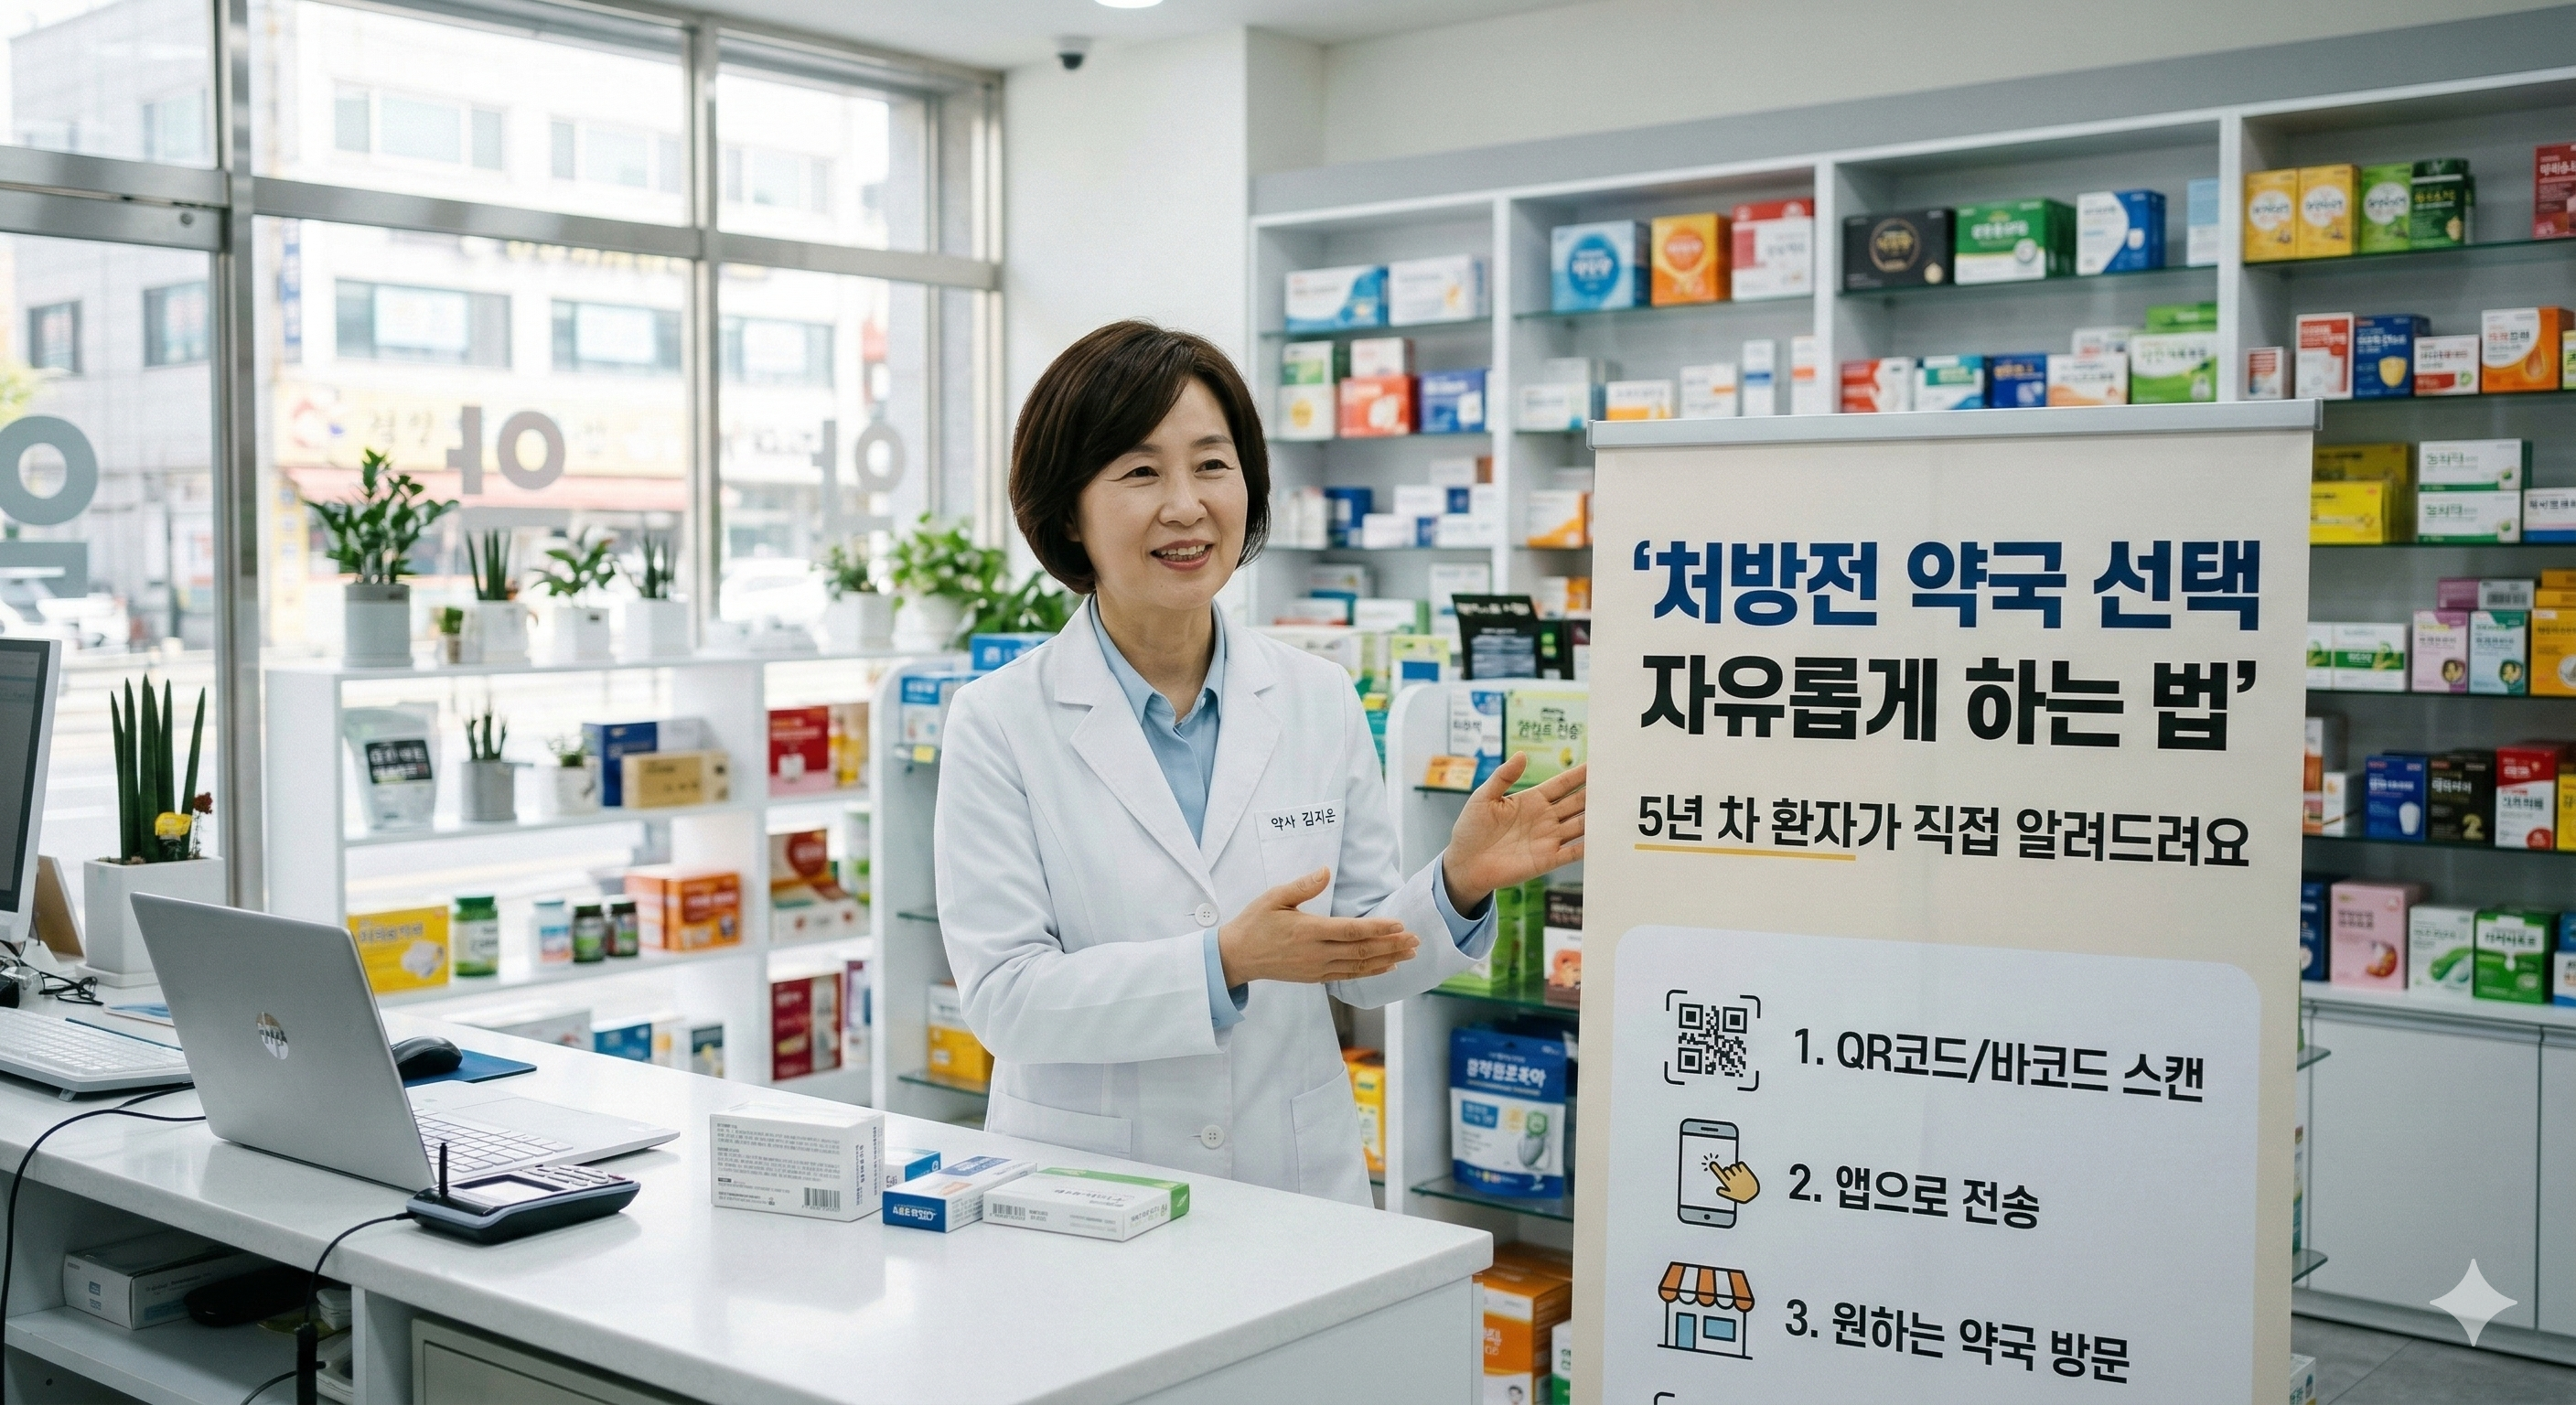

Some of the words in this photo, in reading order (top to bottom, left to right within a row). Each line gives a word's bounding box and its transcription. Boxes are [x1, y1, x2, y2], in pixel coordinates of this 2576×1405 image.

[1906, 541, 2067, 629] 약국
[2093, 540, 2260, 631] 선택
[1640, 654, 1938, 743] 자유롭게
[1965, 657, 2124, 748] 하는
[1271, 815, 1295, 831] 약사
[1302, 808, 1336, 827] 김지은
[1637, 794, 1703, 842] 5년
[1717, 795, 1761, 843] 차
[1771, 797, 1902, 852] 환자가
[1914, 804, 2000, 857] 직접
[2016, 809, 2250, 867] 알려드려요
[1794, 1027, 1824, 1066] 1.
[1837, 1031, 2109, 1092] QR코드/바코드
[2122, 1053, 2204, 1103] 스캔
[1788, 1163, 1822, 1204] 2.
[1836, 1165, 1948, 1217] 앱으로
[1962, 1179, 2040, 1229] 전송
[1785, 1298, 1819, 1338] 3.
[1832, 1302, 1945, 1359] 원하는
[1959, 1318, 2038, 1373] 약국
[2051, 1330, 2131, 1384] 방문
